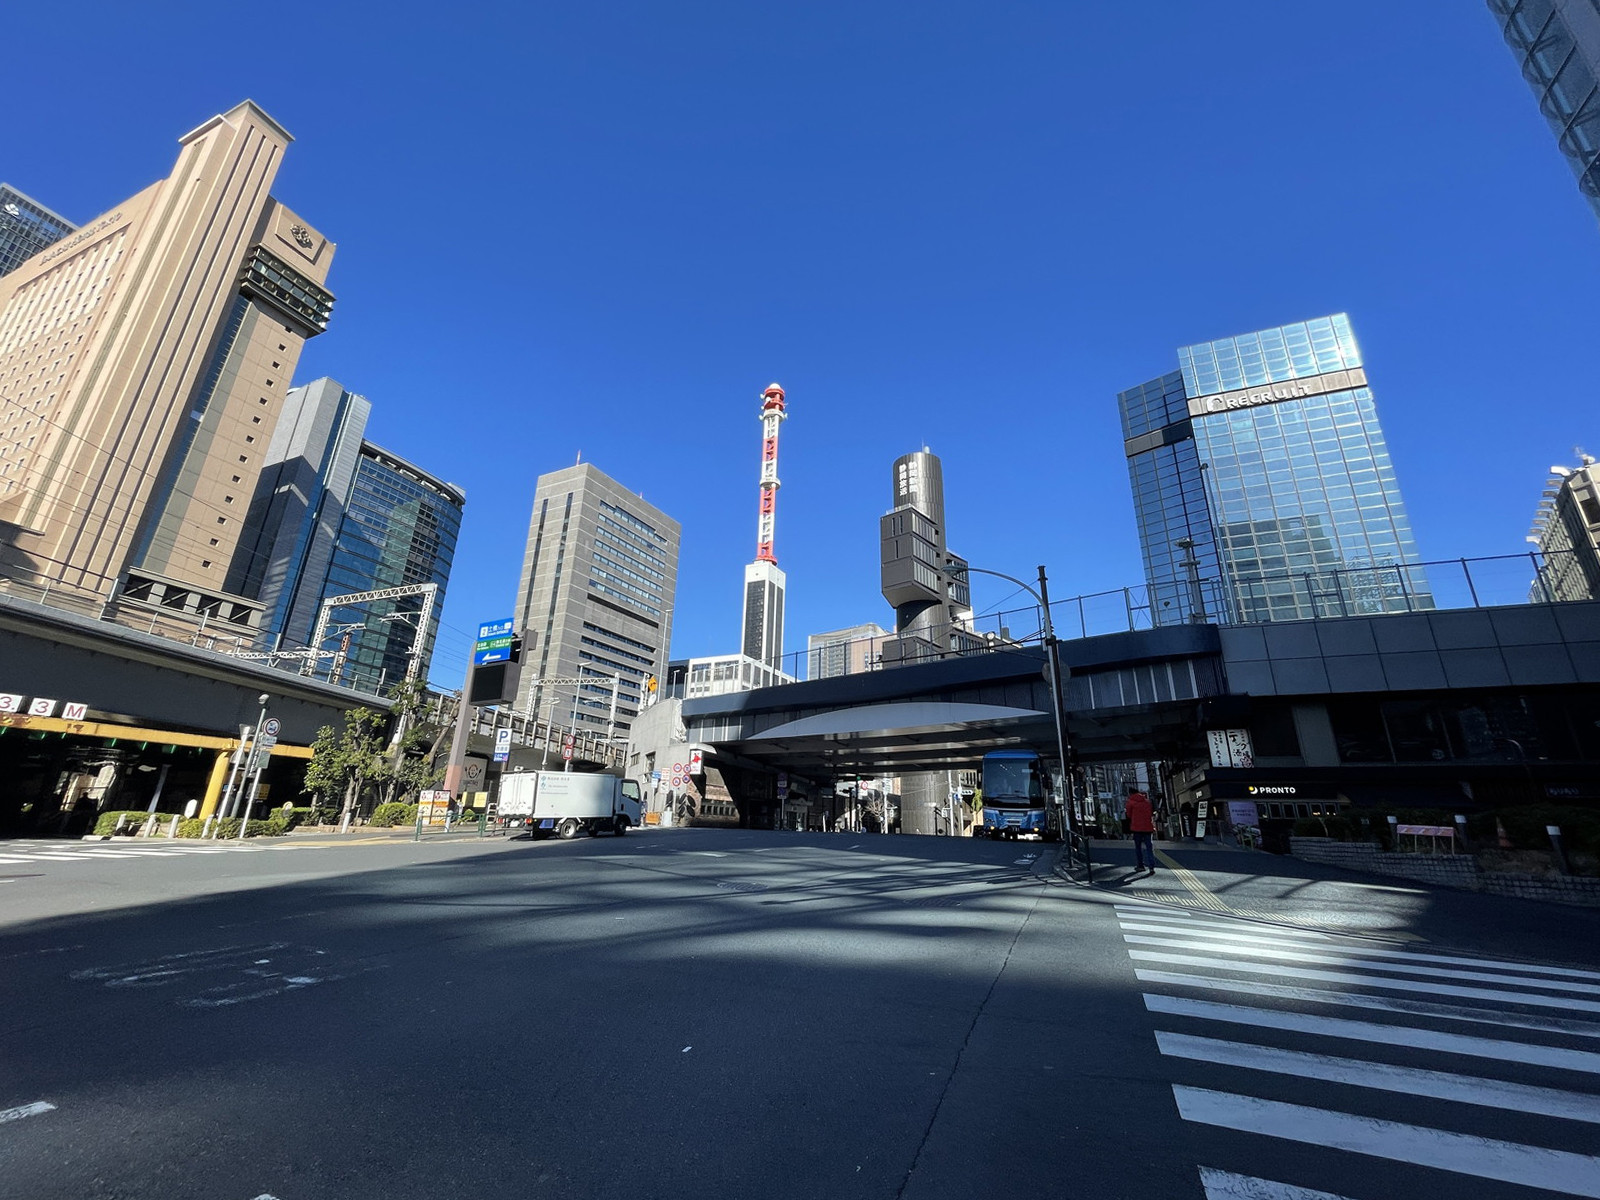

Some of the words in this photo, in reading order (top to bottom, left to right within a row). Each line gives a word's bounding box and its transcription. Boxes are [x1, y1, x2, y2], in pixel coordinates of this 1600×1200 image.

[1226, 385, 1310, 408] RECRUIT
[499, 730, 509, 743] P
[1260, 786, 1296, 794] PRONTO
